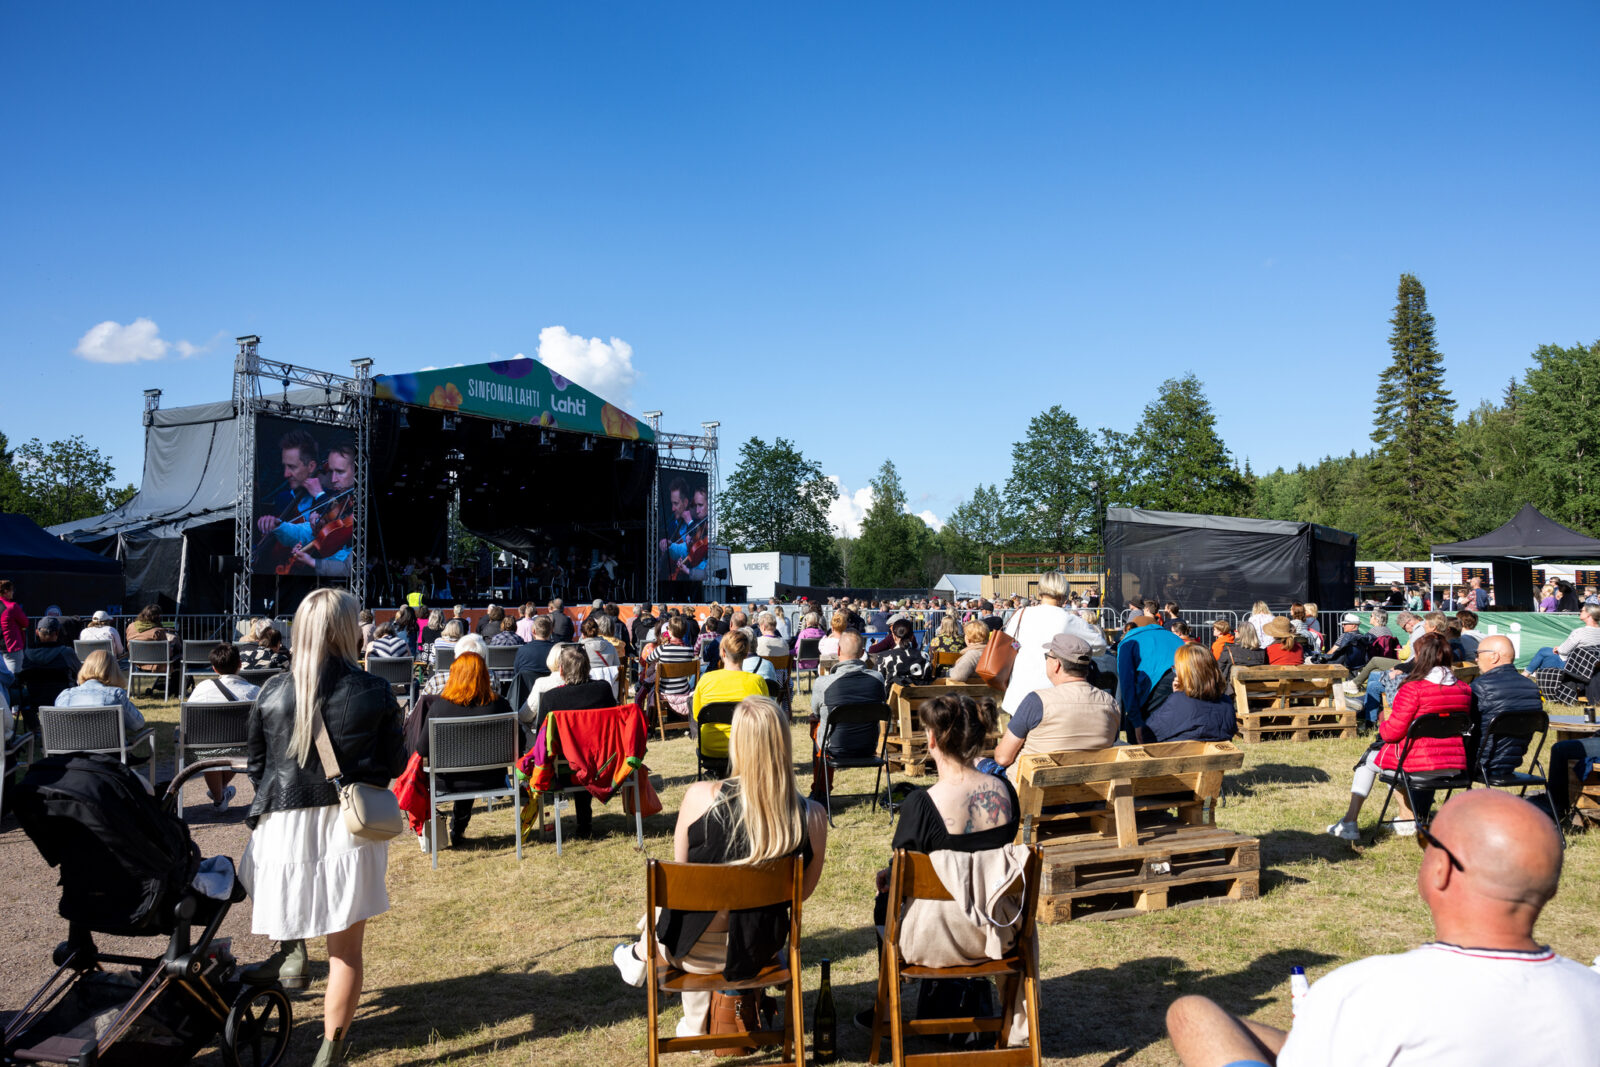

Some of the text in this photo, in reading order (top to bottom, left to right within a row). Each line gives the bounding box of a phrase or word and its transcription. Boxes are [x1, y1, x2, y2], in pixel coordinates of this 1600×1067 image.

[468, 379, 540, 408] SINFONIA LAHTI
[551, 394, 586, 416] Lahti
[743, 563, 769, 571] VIDEPE
